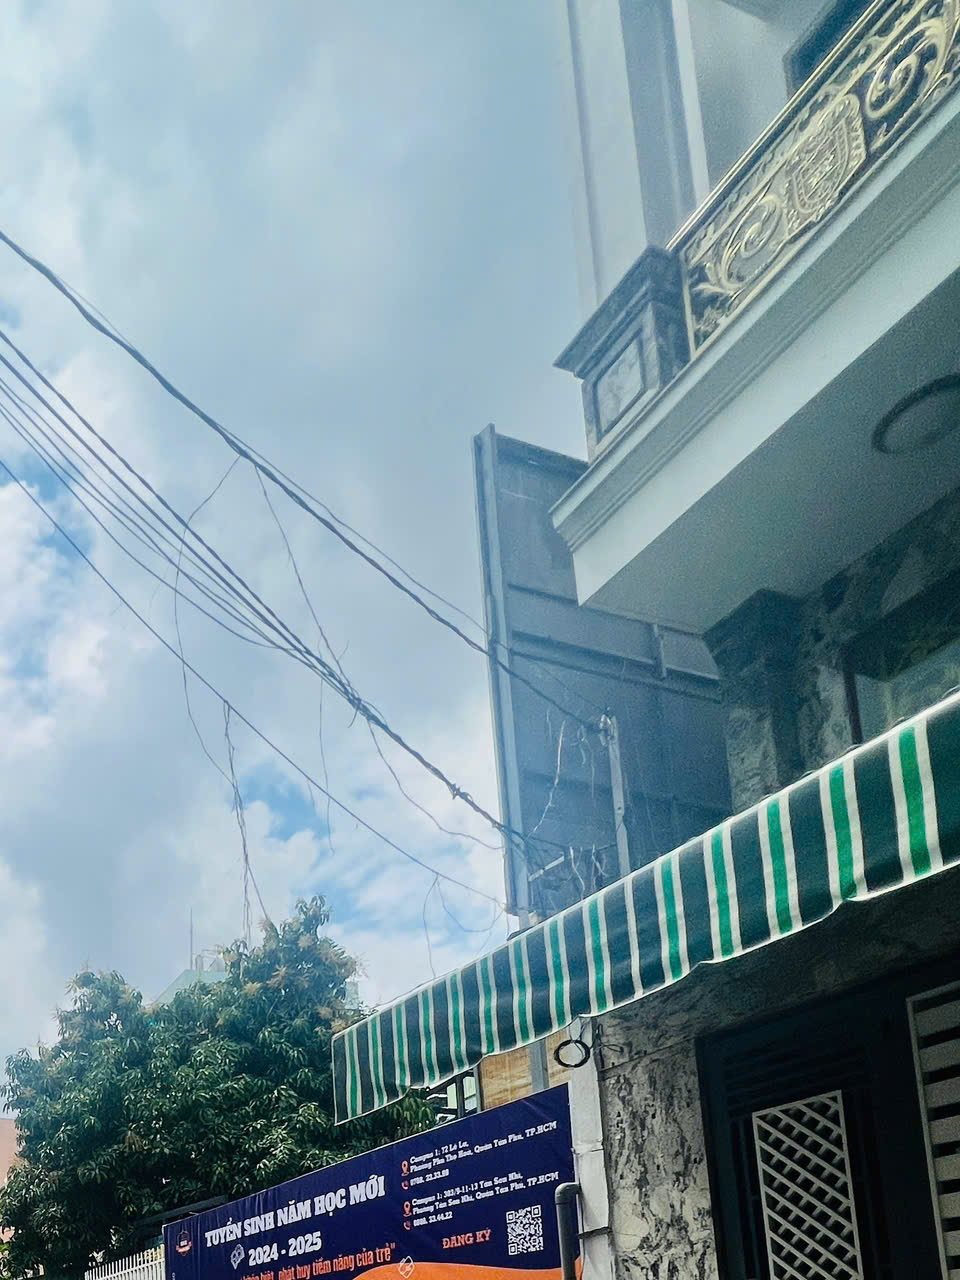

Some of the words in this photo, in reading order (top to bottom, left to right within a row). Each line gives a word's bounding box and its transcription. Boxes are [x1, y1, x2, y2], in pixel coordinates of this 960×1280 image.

[525, 1120, 558, 1138] TP.HCM
[526, 1171, 559, 1188] TP.HCM
[205, 1217, 242, 1248] TUYỂN
[243, 1212, 276, 1237] SINH
[277, 1200, 312, 1228] NĂM
[314, 1188, 347, 1217] HỌC
[348, 1174, 386, 1206] MỚI
[248, 1242, 279, 1267] 2024
[288, 1231, 322, 1258] 2025
[296, 1264, 311, 1280] huy
[332, 1254, 354, 1272] năng
[356, 1248, 374, 1267] của
